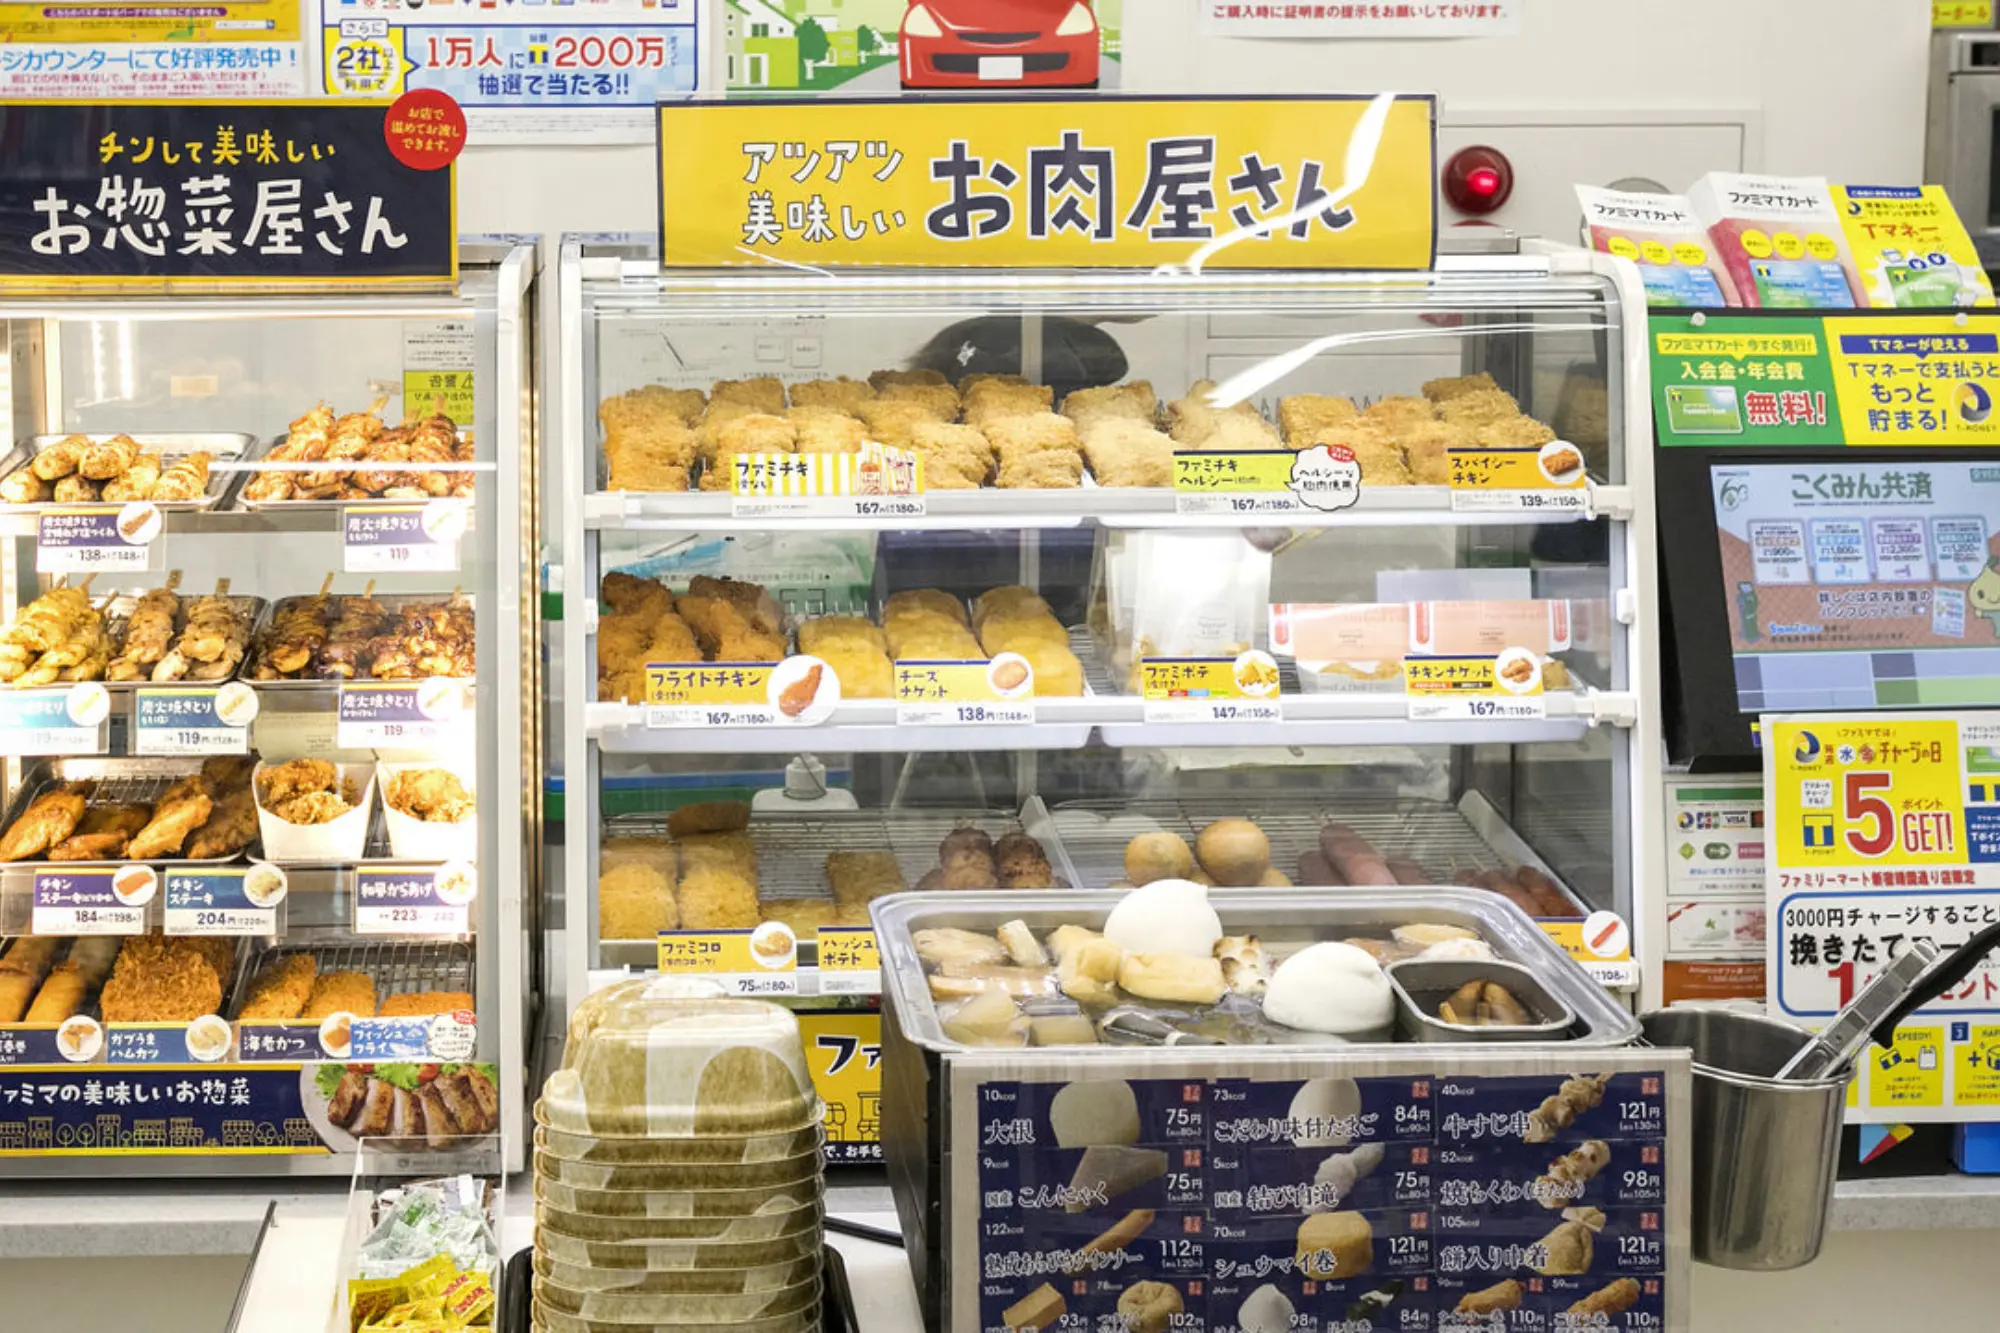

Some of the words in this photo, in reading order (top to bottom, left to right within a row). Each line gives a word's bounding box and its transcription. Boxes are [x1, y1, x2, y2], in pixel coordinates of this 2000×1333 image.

[346, 23, 384, 34] さらに
[0, 47, 297, 71] ジカウンターにて好評発売中！
[337, 46, 381, 70] 2社
[427, 36, 503, 67] 1万人
[554, 36, 665, 67] 200万
[344, 78, 386, 91] 利用で
[477, 73, 629, 96] 抽選で当たる!!
[407, 106, 446, 121] お店で
[98, 124, 337, 166] チンして美味しい
[402, 137, 450, 153] できます。
[741, 139, 905, 184] アツアツ
[923, 128, 1356, 242] お肉屋さん
[1728, 191, 1820, 208] ファミマTカード
[30, 173, 409, 257] お惣菜屋さん
[740, 189, 906, 246] 美味しい
[1593, 203, 1687, 222] ファミマTカード
[1860, 222, 1940, 240] Tマネー
[1661, 337, 1744, 351] ファミマTカード
[1868, 337, 1970, 352] Tマネーが使える
[1680, 360, 1805, 381] 入会金・年会費
[1848, 361, 2000, 379] Tマネーで支払うと
[1870, 382, 1935, 404] もっと
[1746, 391, 1827, 426] 無料!
[1867, 408, 1948, 432] 貯まる!
[735, 460, 809, 478] ファミチキ
[1177, 459, 1239, 474] ファミチキ
[1451, 456, 1517, 470] スパイシー
[1452, 471, 1492, 485] チキン
[1790, 471, 1933, 500] こくみん共済
[1144, 664, 1210, 680] ファミポテ
[1838, 746, 1854, 762] 水
[1902, 798, 1943, 811] ポイント
[1844, 772, 1896, 856] 5
[1902, 812, 1954, 854] GET!
[39, 878, 73, 892] チキン
[169, 878, 206, 892] チキン
[170, 893, 215, 906] ステーキ
[1785, 904, 2000, 928] 3000円チャージするごと
[661, 940, 723, 956] ファミコロ
[823, 951, 862, 967] ポテト
[110, 1032, 156, 1046] ガブうま
[248, 1035, 307, 1052] 海老かつ
[353, 1029, 405, 1041] フィッシュ
[110, 1048, 159, 1060] ハムカツ
[353, 1042, 391, 1054] フライ
[0, 1078, 251, 1107] ァミマの美味しいお惣菜
[1165, 1108, 1203, 1125] 75円
[1394, 1105, 1431, 1122] 84円
[1618, 1101, 1661, 1120] 121円
[984, 1117, 1037, 1145] 大根
[1166, 1173, 1204, 1190] 75円
[1394, 1171, 1431, 1189] 75円
[1622, 1170, 1660, 1188] 98円
[1018, 1180, 1109, 1208] こんにゃく
[1159, 1239, 1203, 1258] 112円
[1388, 1236, 1429, 1254] 121円
[1617, 1236, 1660, 1254] 121円
[1058, 1313, 1089, 1327] 93円
[1167, 1312, 1204, 1327] 102円
[1400, 1308, 1430, 1323] 84円
[1510, 1309, 1546, 1324] 110円
[1625, 1311, 1660, 1326] 110円
